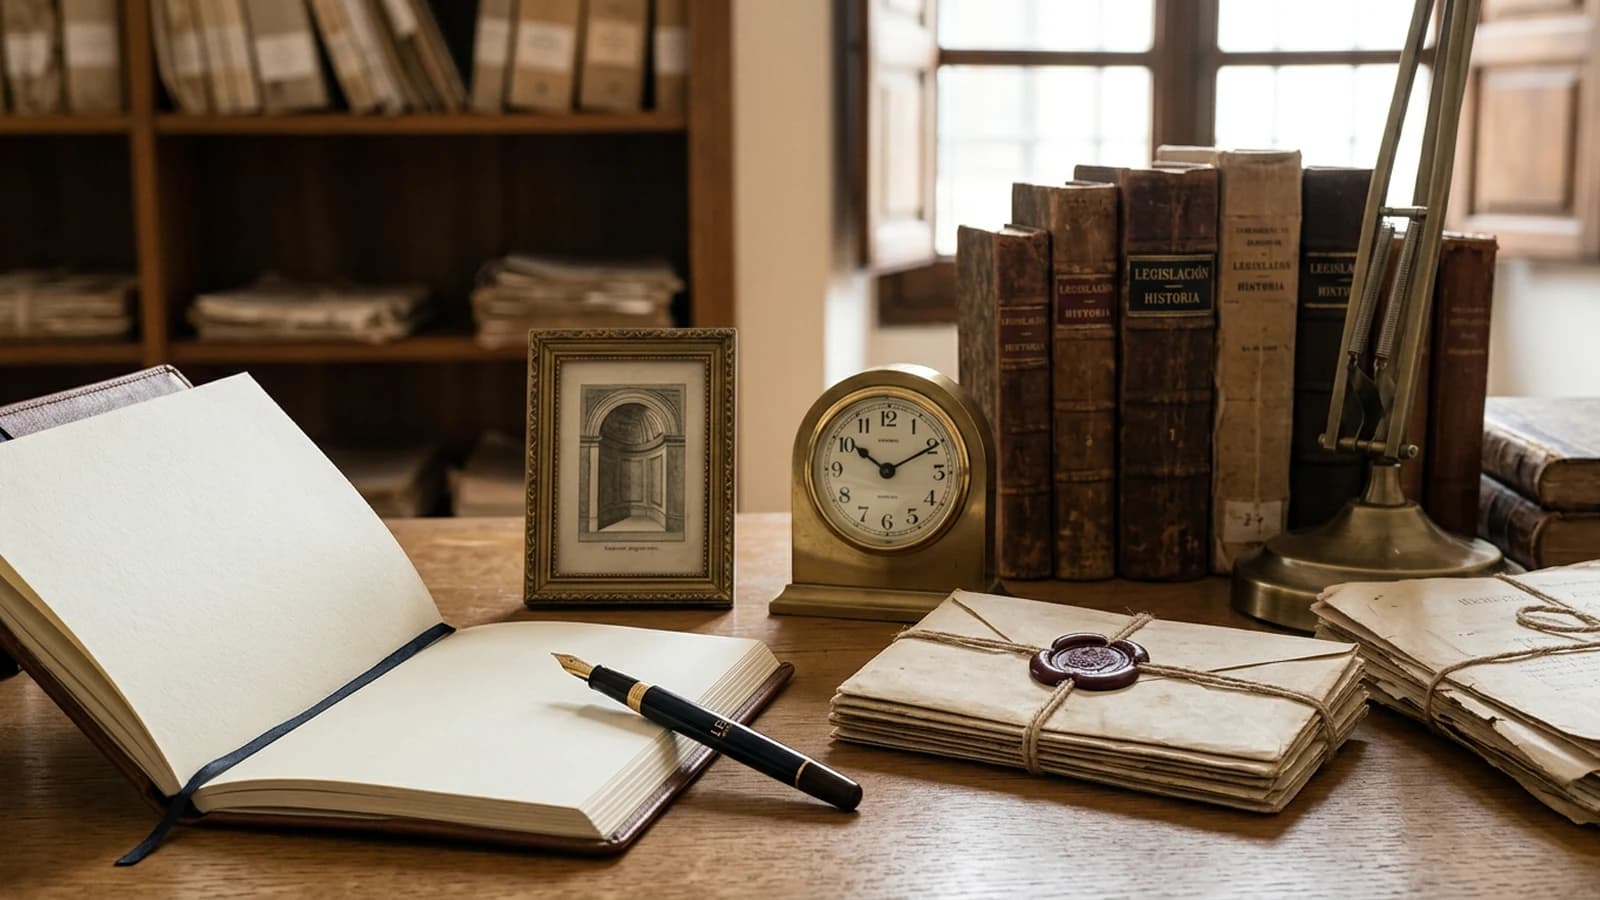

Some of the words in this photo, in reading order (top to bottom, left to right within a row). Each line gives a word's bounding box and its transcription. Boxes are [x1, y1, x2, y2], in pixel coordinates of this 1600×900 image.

[1135, 265, 1209, 280] LEGISLACIÓN
[1144, 292, 1200, 305] HISTORIA
[858, 417, 870, 434] 11
[880, 410, 897, 427] 12
[911, 418, 916, 435] 1
[838, 436, 855, 453] 10
[926, 438, 939, 455] 2
[831, 461, 844, 478] 9
[933, 464, 945, 481] 3
[838, 486, 851, 503] 8
[923, 489, 937, 506] 4
[857, 505, 869, 523] 7
[881, 513, 893, 530] 6
[906, 508, 919, 525] 5
